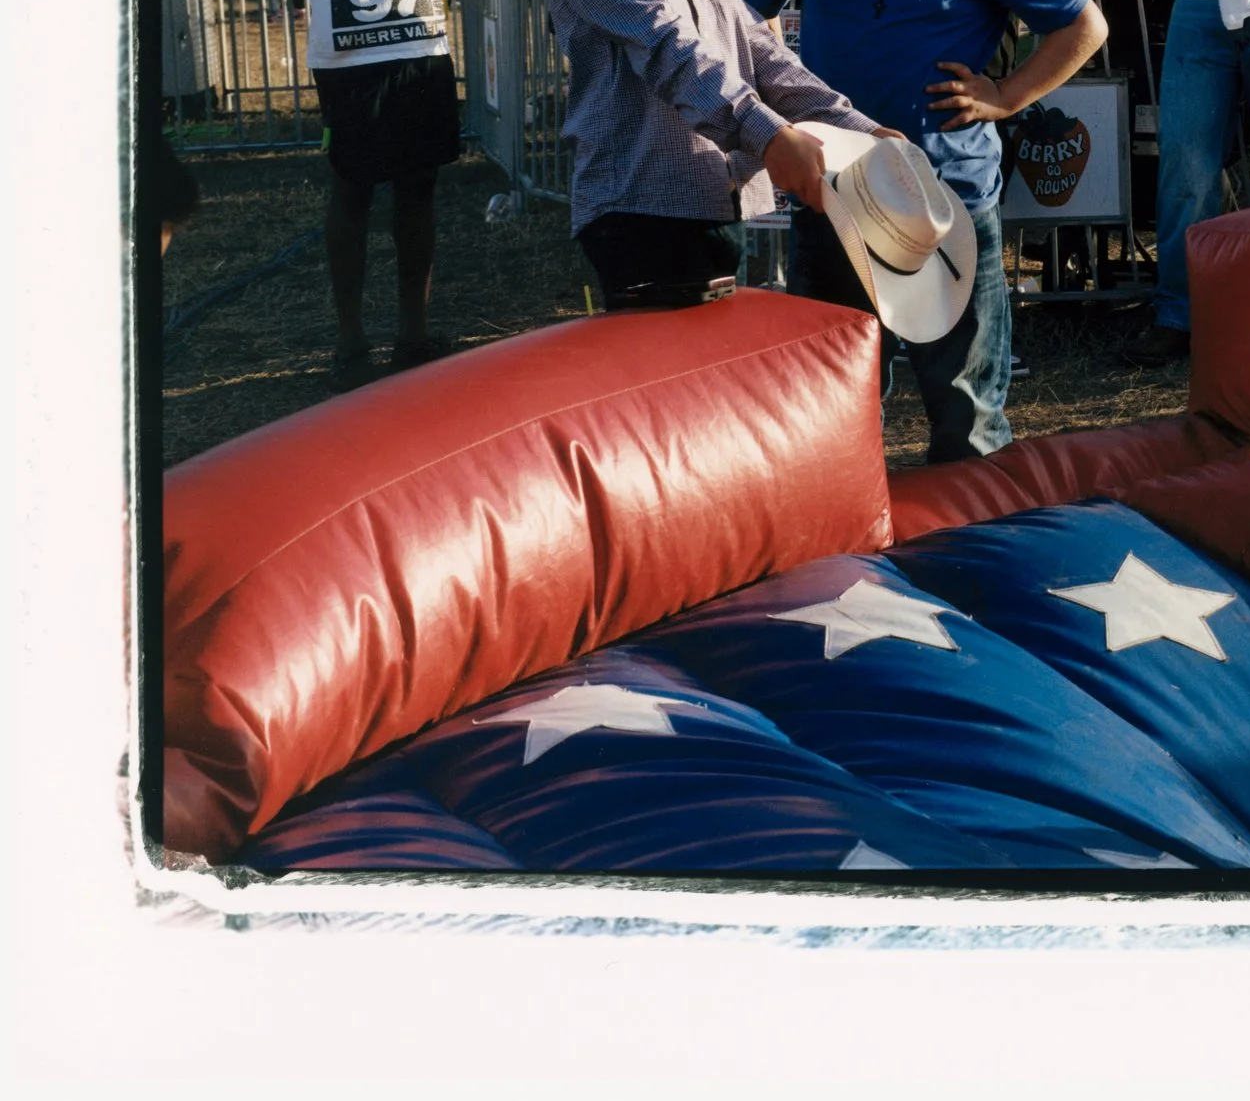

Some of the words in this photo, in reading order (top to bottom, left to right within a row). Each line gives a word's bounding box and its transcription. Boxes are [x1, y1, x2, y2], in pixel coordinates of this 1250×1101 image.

[337, 28, 402, 48] WHERE
[1018, 133, 1085, 164] BERRY
[1047, 164, 1062, 177] GO
[1034, 172, 1077, 196] ROUND
